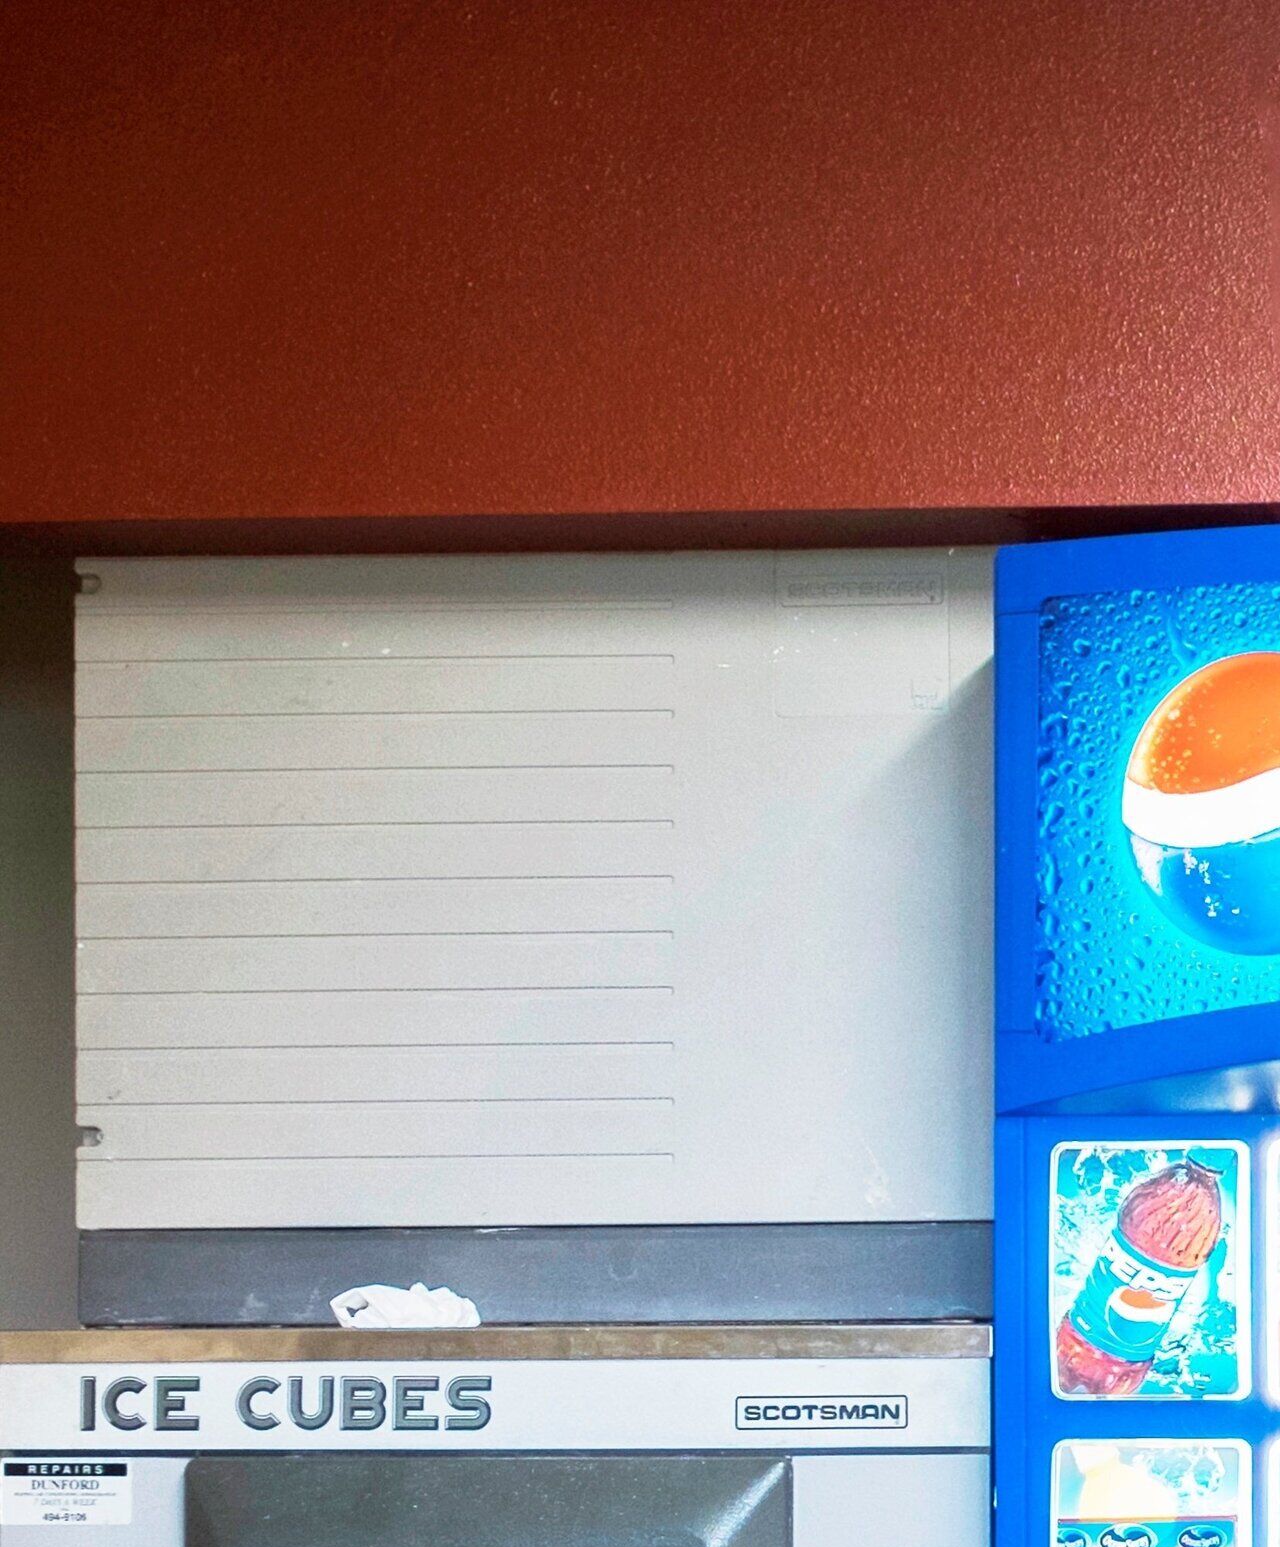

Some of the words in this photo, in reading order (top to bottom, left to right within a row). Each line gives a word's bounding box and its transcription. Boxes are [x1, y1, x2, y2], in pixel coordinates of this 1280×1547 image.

[80, 1375, 200, 1432] ICE
[235, 1375, 492, 1432] CUBES
[744, 1404, 900, 1421] SCOTSMAN
[27, 1465, 104, 1475] REPAIRS
[31, 1479, 100, 1490] DUNFORD
